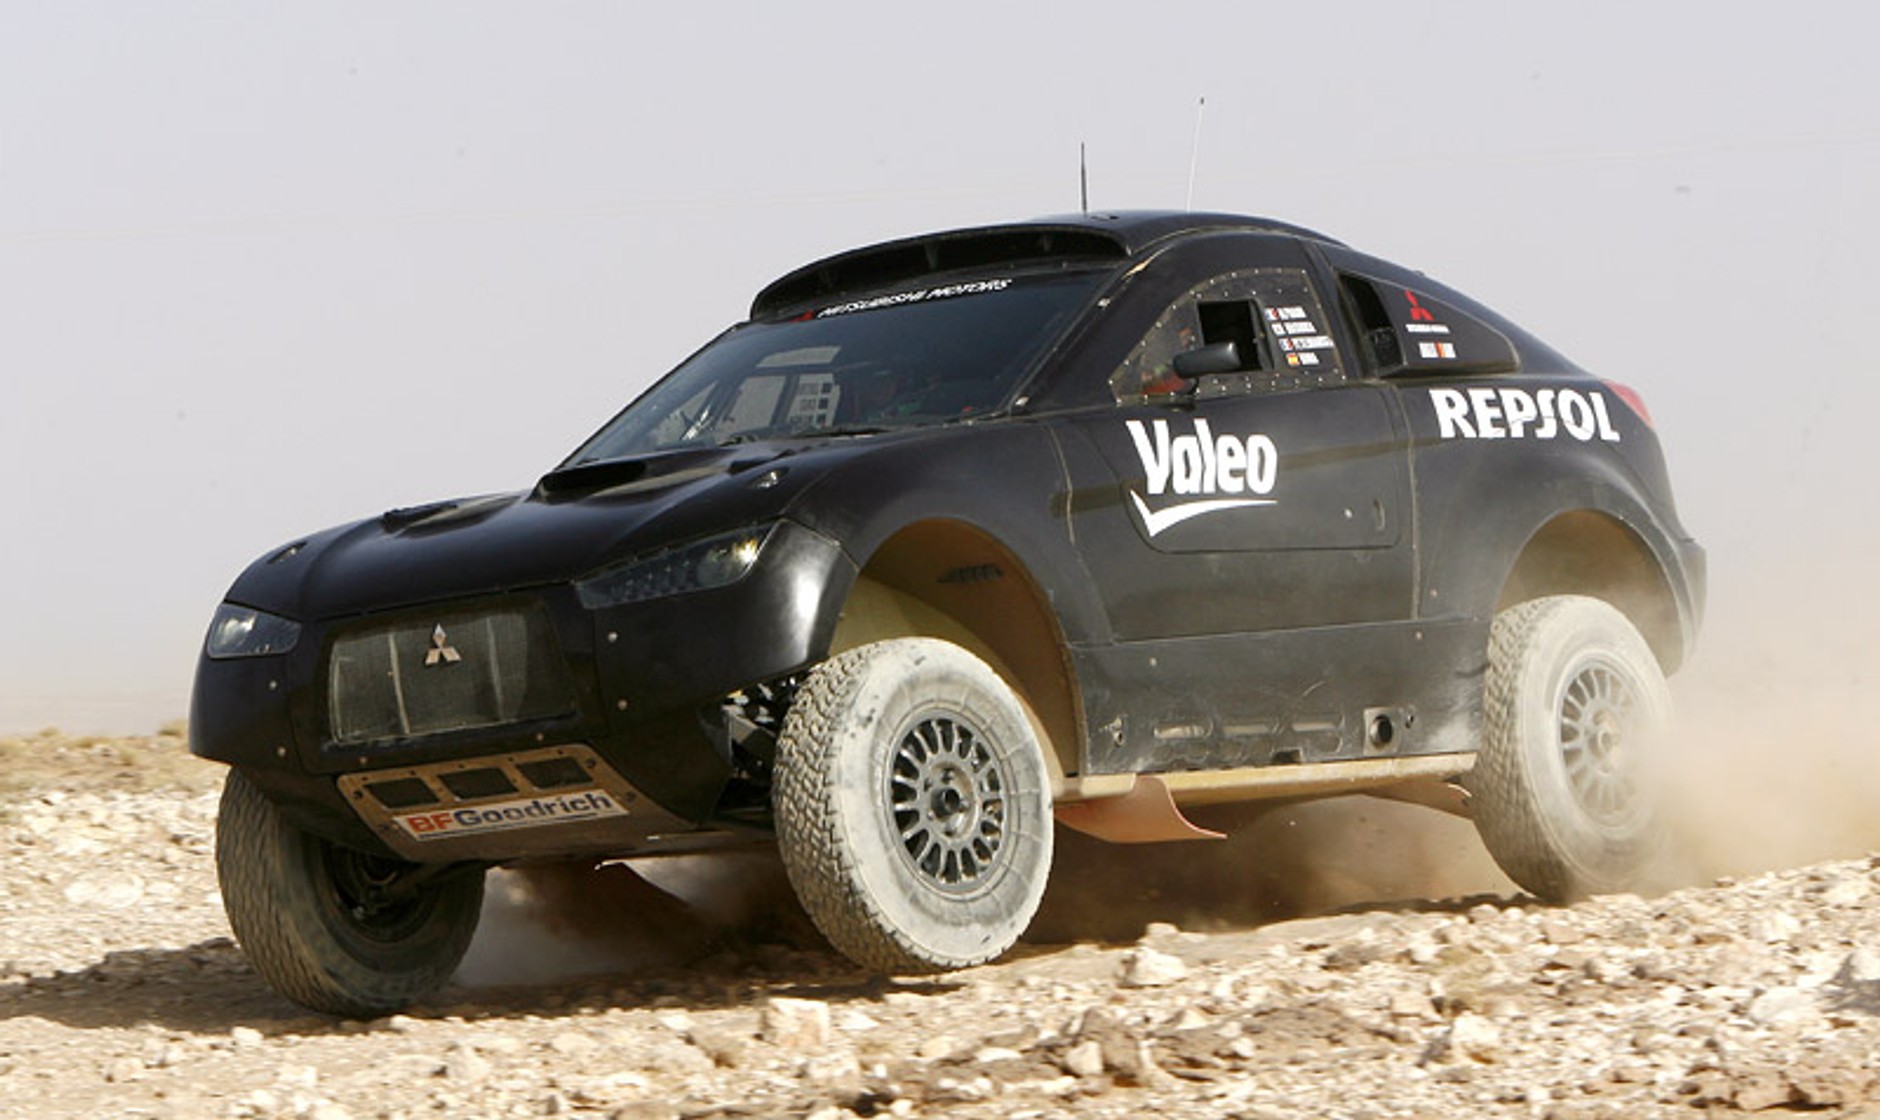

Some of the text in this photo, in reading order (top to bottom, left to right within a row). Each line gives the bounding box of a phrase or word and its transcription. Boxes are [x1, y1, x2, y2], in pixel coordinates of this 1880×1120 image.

[1429, 388, 1620, 443] REPSOL
[1126, 418, 1277, 495] Valeo
[406, 792, 612, 834] BFGoodrich
